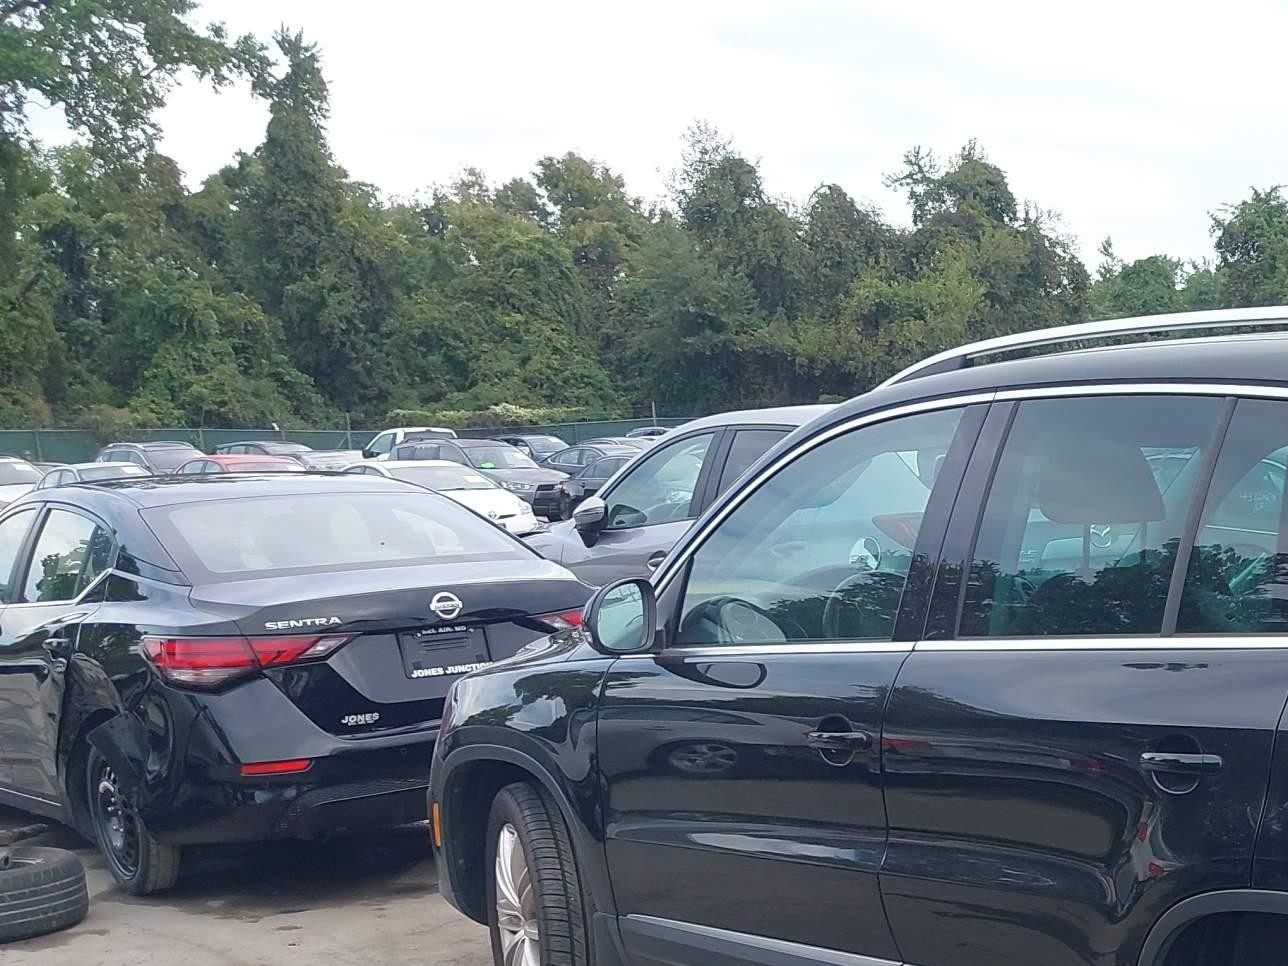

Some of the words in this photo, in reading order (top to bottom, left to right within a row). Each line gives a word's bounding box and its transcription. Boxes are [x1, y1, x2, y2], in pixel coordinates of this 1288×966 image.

[264, 616, 343, 630] SENTRA
[411, 667, 444, 678] JONES
[341, 712, 380, 723] JONES
